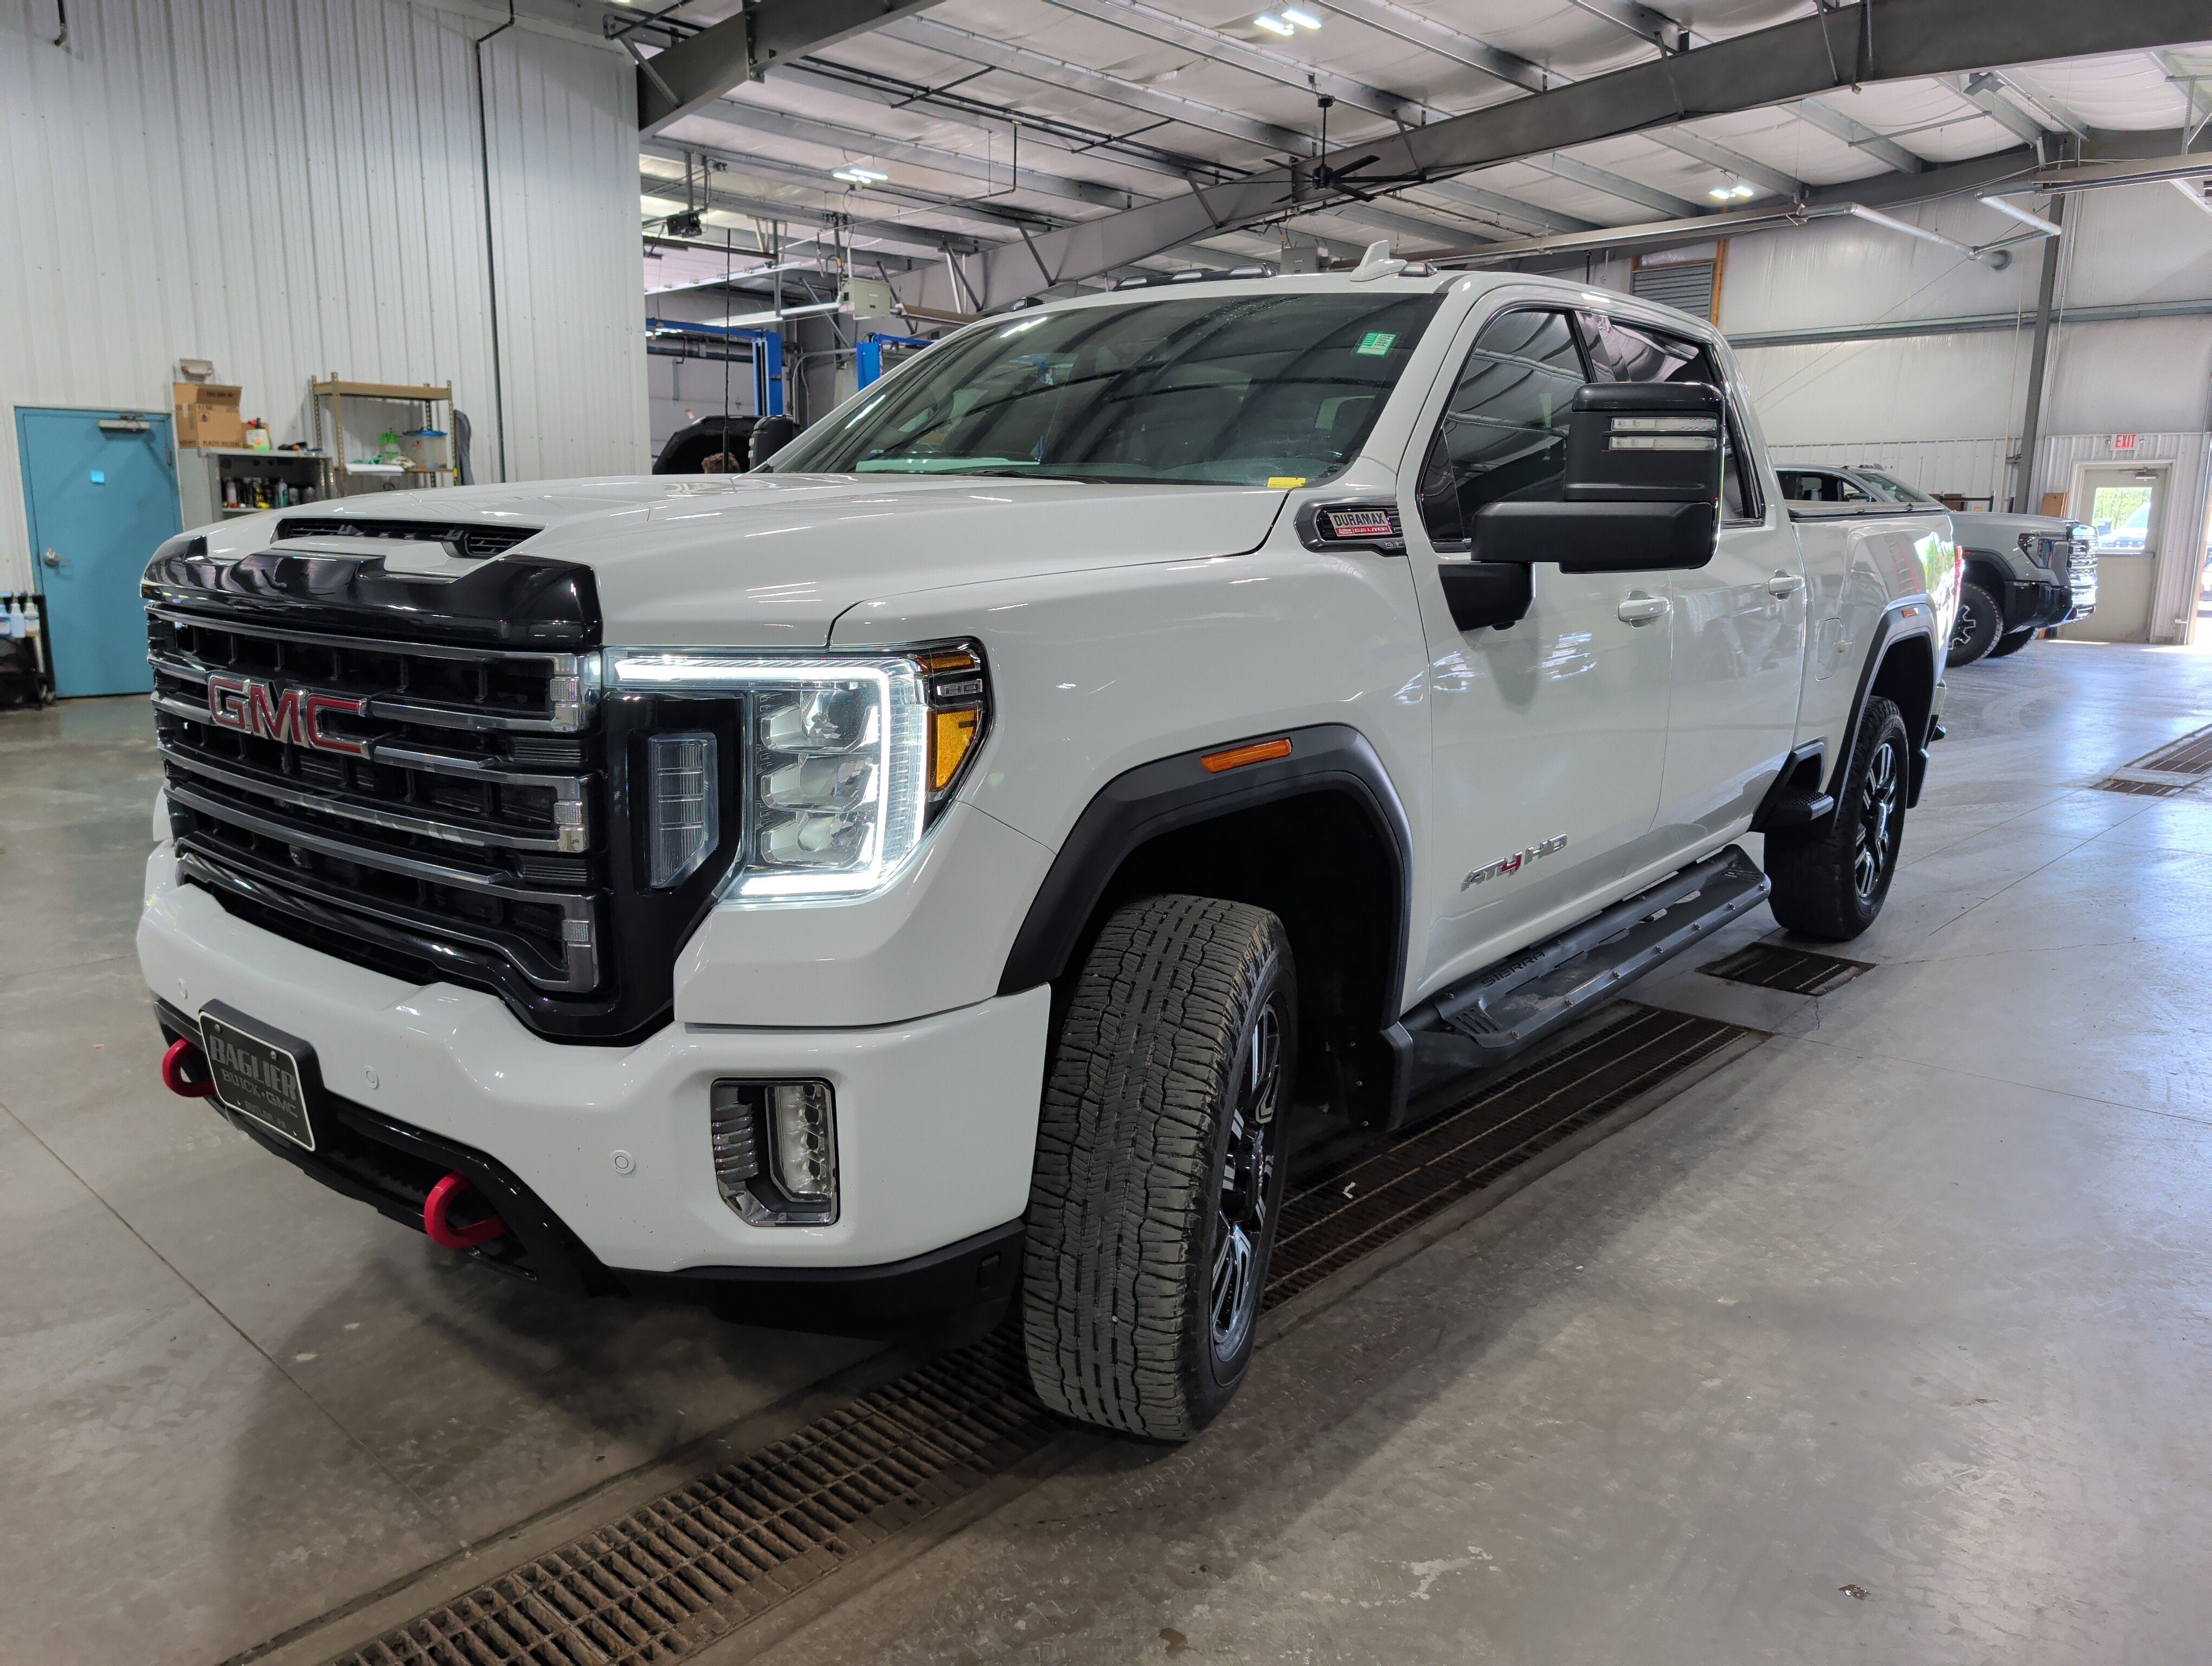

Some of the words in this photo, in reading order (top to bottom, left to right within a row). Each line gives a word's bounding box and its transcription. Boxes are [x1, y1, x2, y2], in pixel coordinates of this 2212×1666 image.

[2115, 434, 2136, 448] EXIT
[1333, 512, 1386, 527] DURAMAX
[208, 675, 371, 759] GMC
[1461, 851, 1523, 892] AT4
[1524, 834, 1568, 865] HD
[1481, 951, 1545, 987] SIERRA
[210, 1035, 297, 1101] BAGLIER
[221, 1068, 261, 1098] BUICK
[265, 1091, 298, 1118] GMC
